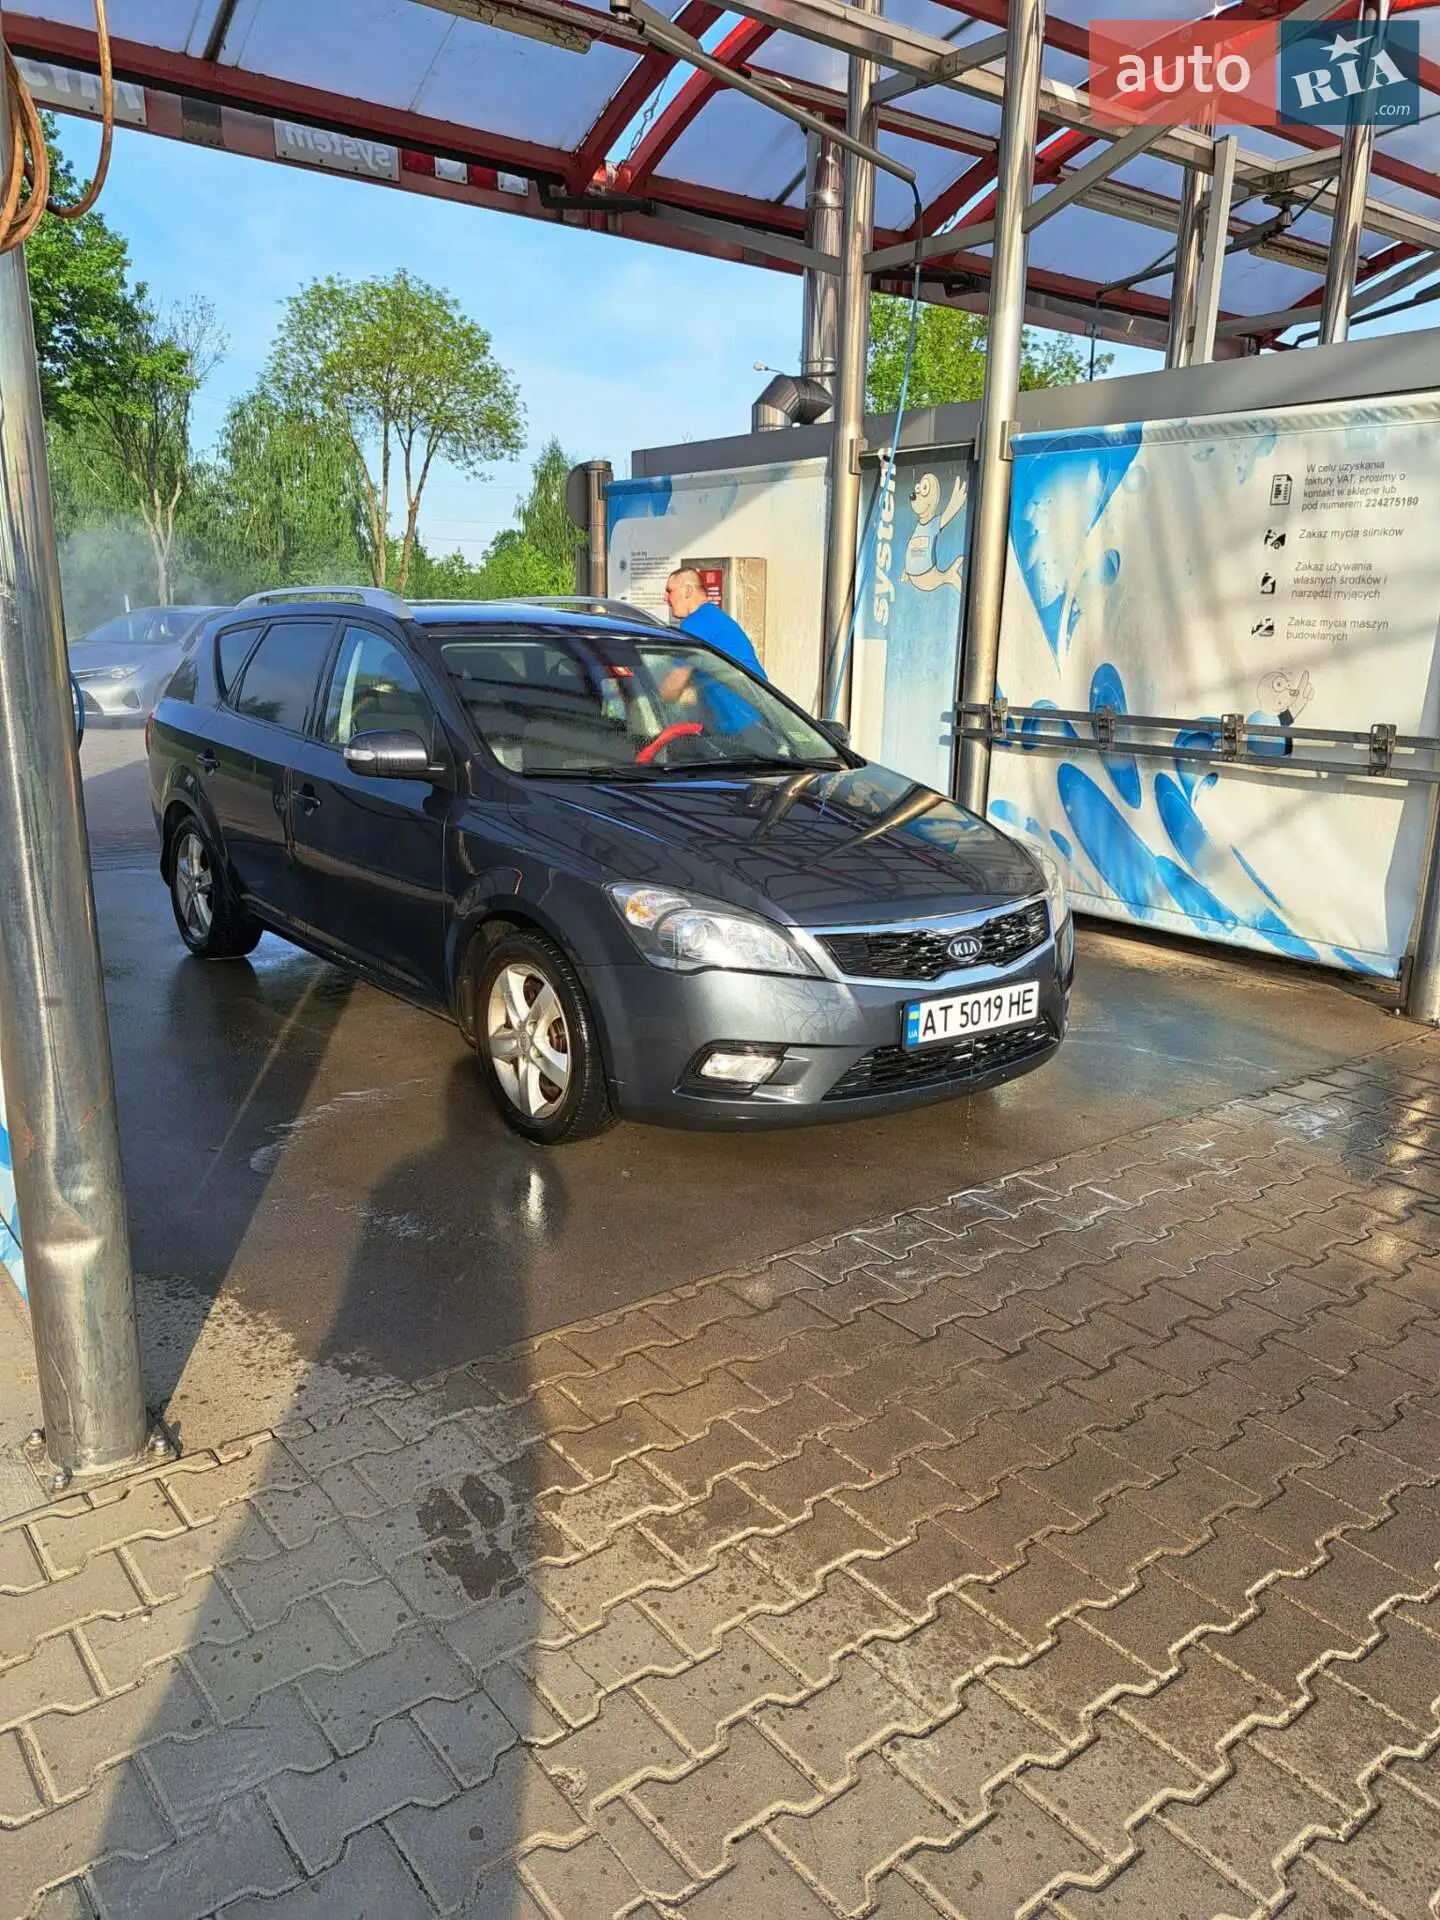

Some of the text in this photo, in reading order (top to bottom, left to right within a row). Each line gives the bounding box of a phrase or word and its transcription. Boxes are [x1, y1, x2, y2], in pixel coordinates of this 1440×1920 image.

[1306, 460, 1386, 473] W celu uzyskania
[1305, 475, 1334, 486] faktury
[1336, 474, 1356, 485] VAT,
[1359, 472, 1397, 483] prosimy
[1303, 485, 1397, 498] kontakt w sklepie lub
[1301, 496, 1419, 512] pod numerem 224275180
[1299, 529, 1328, 539] Zakaz
[1330, 528, 1360, 540] mycia
[1295, 562, 1324, 571] Zakaz
[1288, 617, 1389, 631] Zakaz mycia maszyn
[1286, 630, 1348, 642] budowlanych
[954, 941, 977, 956] KIA
[922, 989, 1034, 1037] AT 5019 HE
